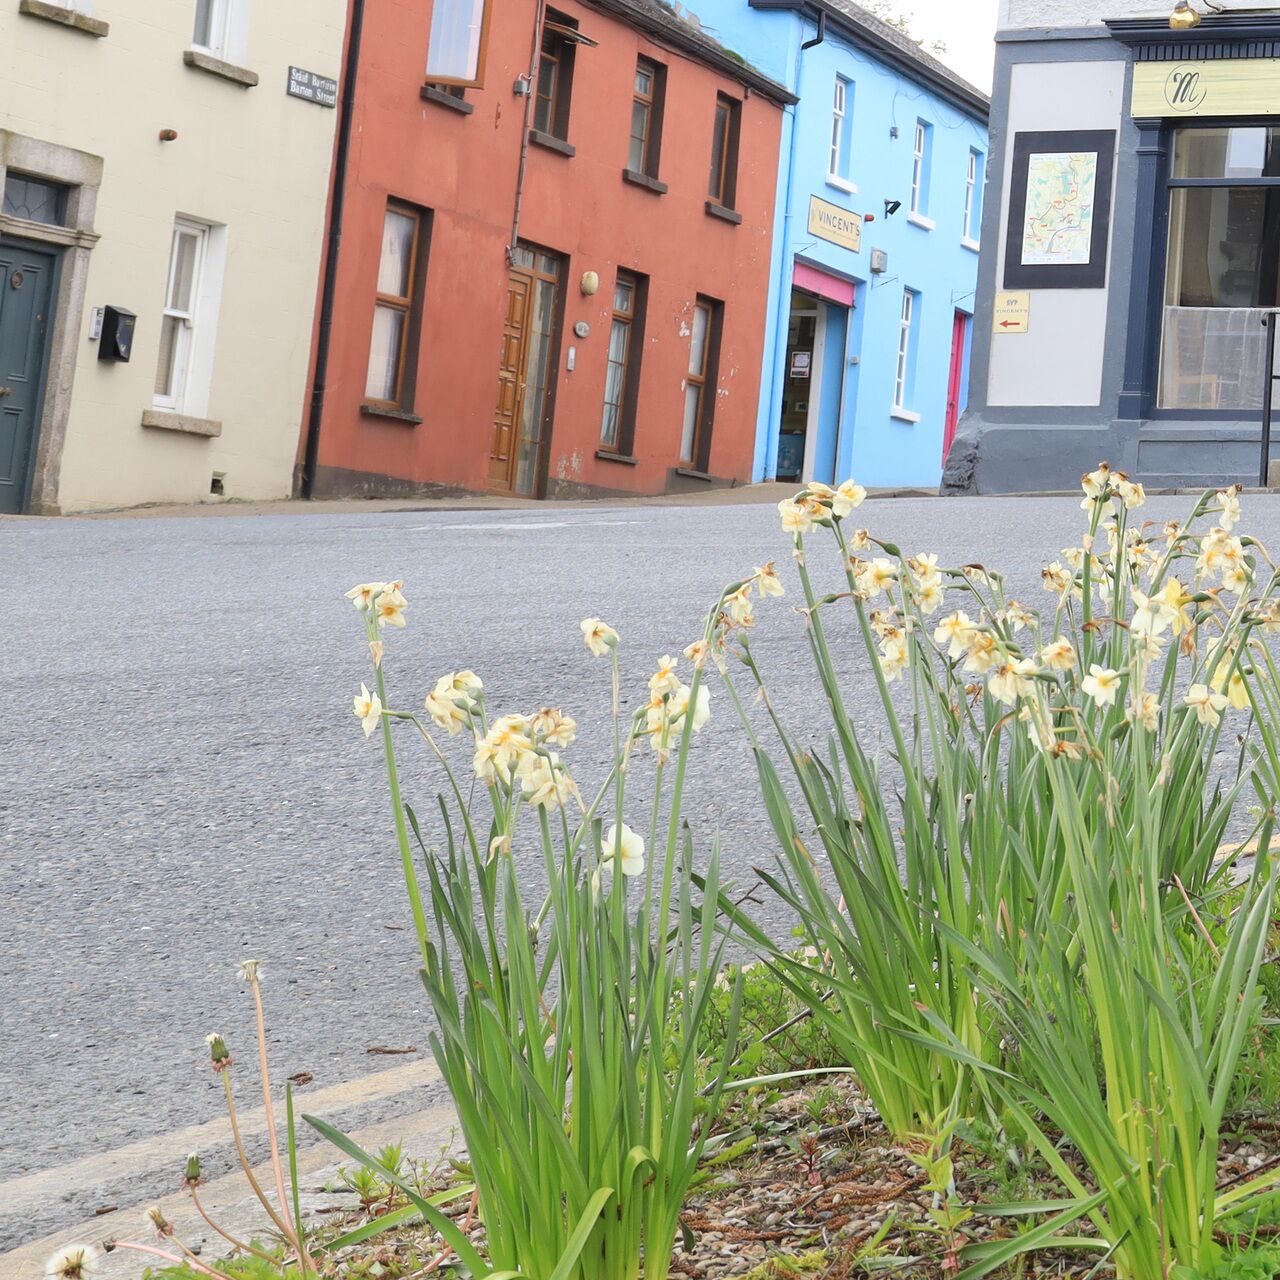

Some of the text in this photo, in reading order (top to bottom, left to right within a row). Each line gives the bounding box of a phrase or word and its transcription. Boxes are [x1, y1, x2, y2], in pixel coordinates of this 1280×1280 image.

[290, 79, 335, 104] Barton Street
[819, 210, 860, 237] VINCENT'S
